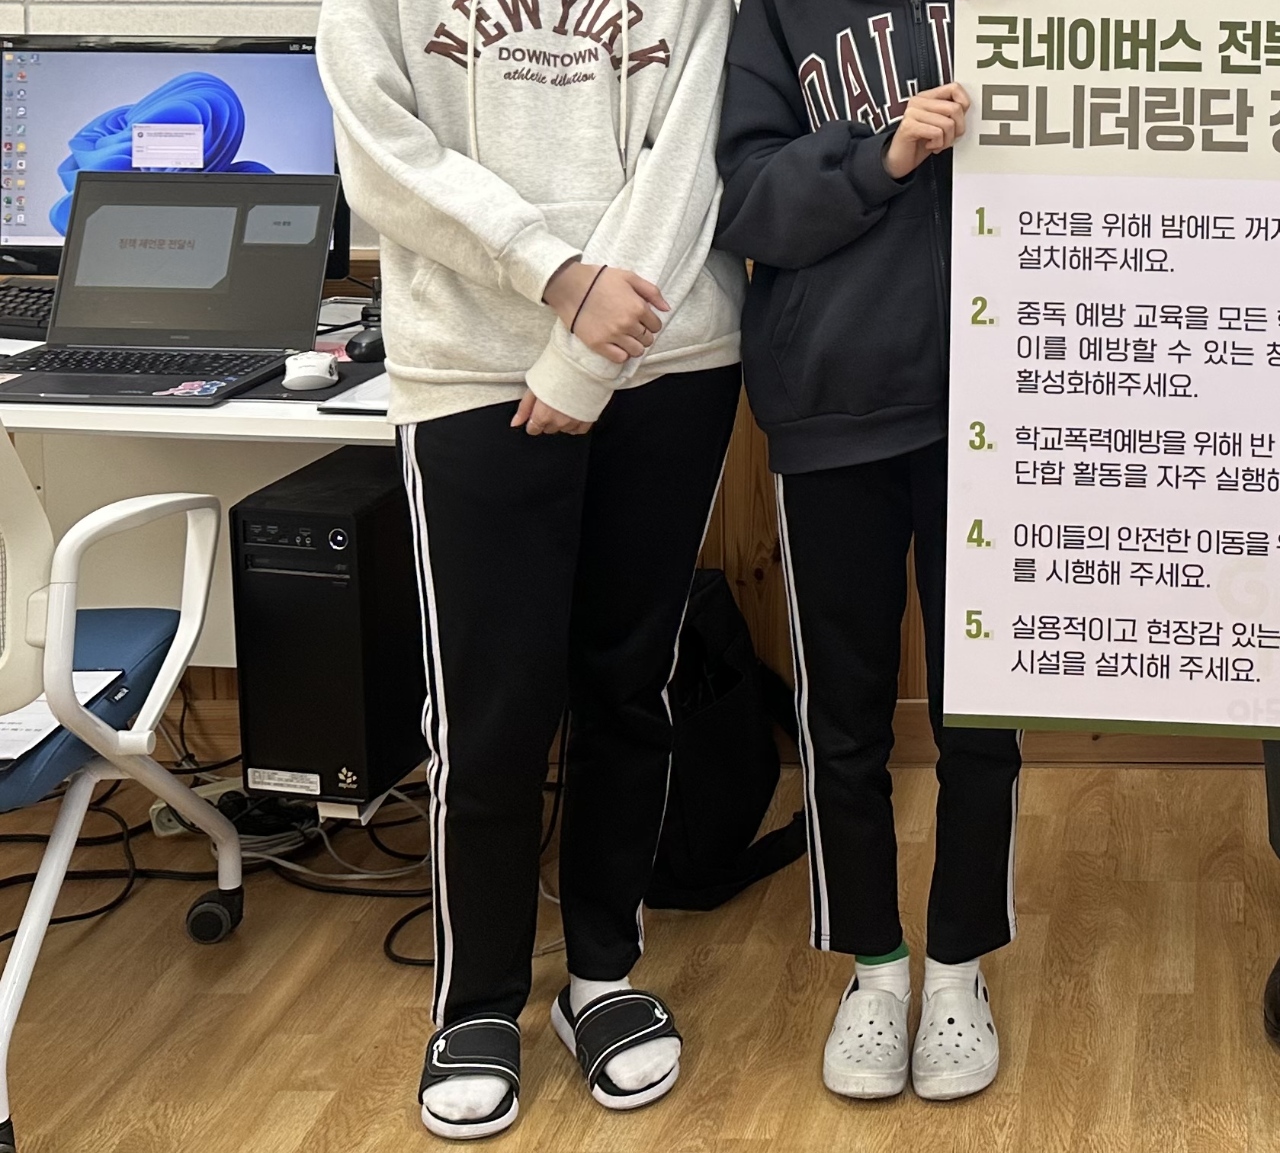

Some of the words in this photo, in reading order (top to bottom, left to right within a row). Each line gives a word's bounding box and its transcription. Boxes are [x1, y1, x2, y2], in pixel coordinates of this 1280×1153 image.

[498, 47, 599, 68] DOWNTOWN
[976, 15, 1203, 73] 굿네이버스
[503, 67, 547, 84] athletic
[550, 70, 596, 87] dilution
[978, 84, 1254, 153] 모니터링단
[975, 206, 993, 235] 1.
[1018, 211, 1093, 237] 안전을
[1101, 213, 1151, 239] 위해
[1161, 214, 1236, 240] 밤에도
[1018, 245, 1175, 273] 설치해주세요.
[971, 296, 995, 325] 2.
[1017, 301, 1067, 327] 중독
[1075, 302, 1127, 328] 예방
[1133, 304, 1209, 331] 교육을
[1217, 306, 1268, 332] 모든
[1017, 335, 1067, 361] 이를
[1079, 336, 1158, 363] 예방할
[1167, 339, 1192, 364] 수
[1204, 340, 1255, 366] 있는
[1015, 368, 1198, 398] 활성화해주세요.
[968, 421, 994, 451] 3.
[1015, 425, 1187, 455] 학교폭력예방을
[1193, 431, 1242, 458] 위해
[1250, 433, 1276, 459] 반
[1015, 460, 1066, 486] 단합
[1072, 461, 1148, 489] 활동을
[1156, 464, 1207, 491] 자주
[966, 518, 992, 548] 4.
[1014, 523, 1110, 551] 아이들의
[1117, 526, 1192, 554] 안전한
[1197, 529, 1270, 557] 이동을
[1012, 557, 1037, 583] 를
[1045, 559, 1121, 586] 시행해
[1129, 561, 1211, 588] 주세요.
[965, 609, 990, 639] 5.
[1012, 614, 1138, 643] 실용적이고
[1146, 618, 1224, 647] 현장감
[1010, 649, 1087, 676] 시설을
[1095, 652, 1170, 680] 설치해
[1179, 655, 1261, 683] 주세요.
